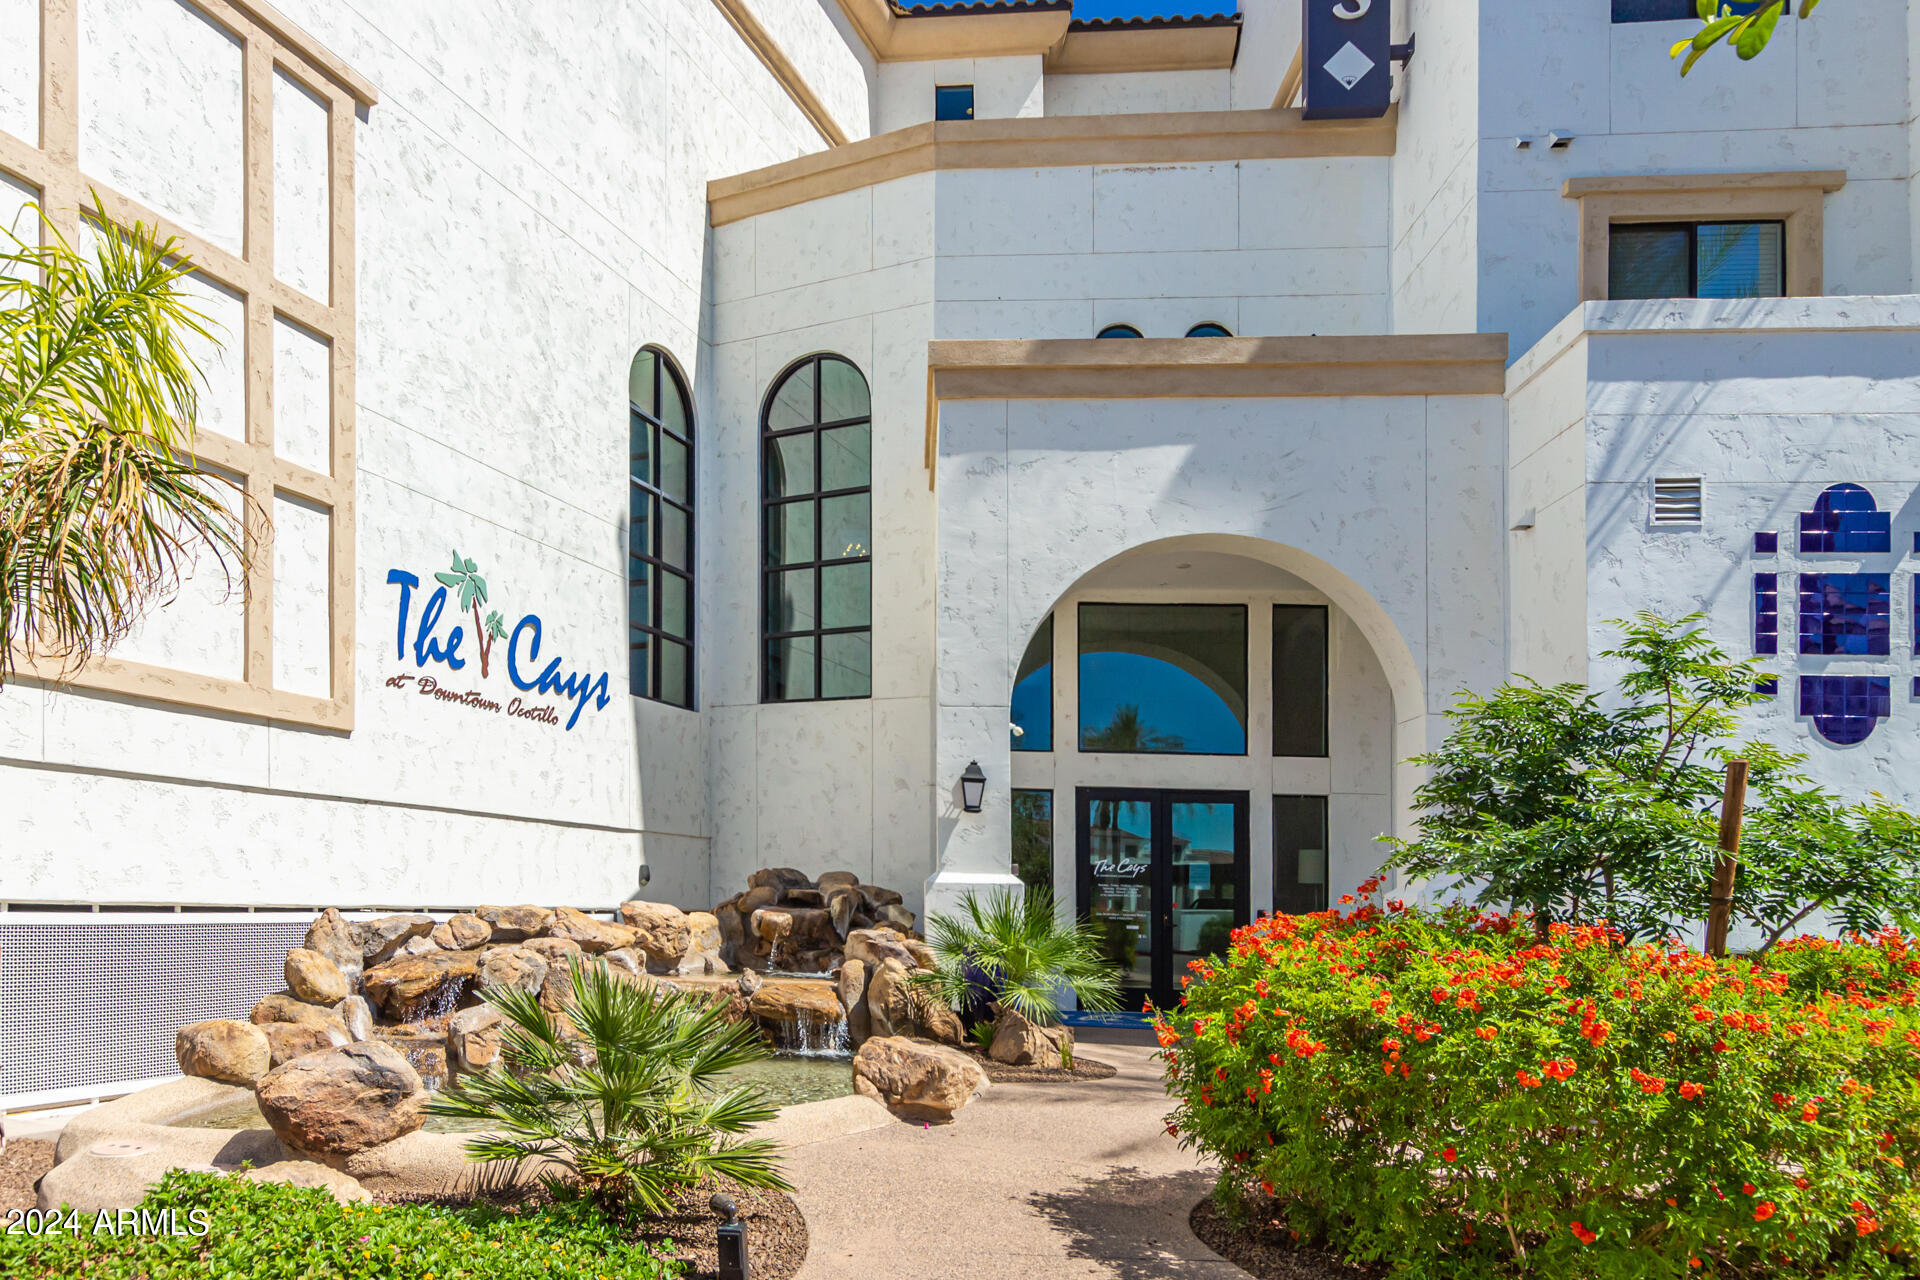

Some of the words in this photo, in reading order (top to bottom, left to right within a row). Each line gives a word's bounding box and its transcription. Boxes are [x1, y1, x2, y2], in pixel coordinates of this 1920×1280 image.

[387, 569, 465, 670] The
[508, 614, 610, 731] Cays
[385, 673, 415, 689] at
[417, 675, 502, 713] Downtown
[507, 697, 559, 726] Ocotillo
[1093, 859, 1116, 876] The
[1117, 858, 1148, 878] Cays
